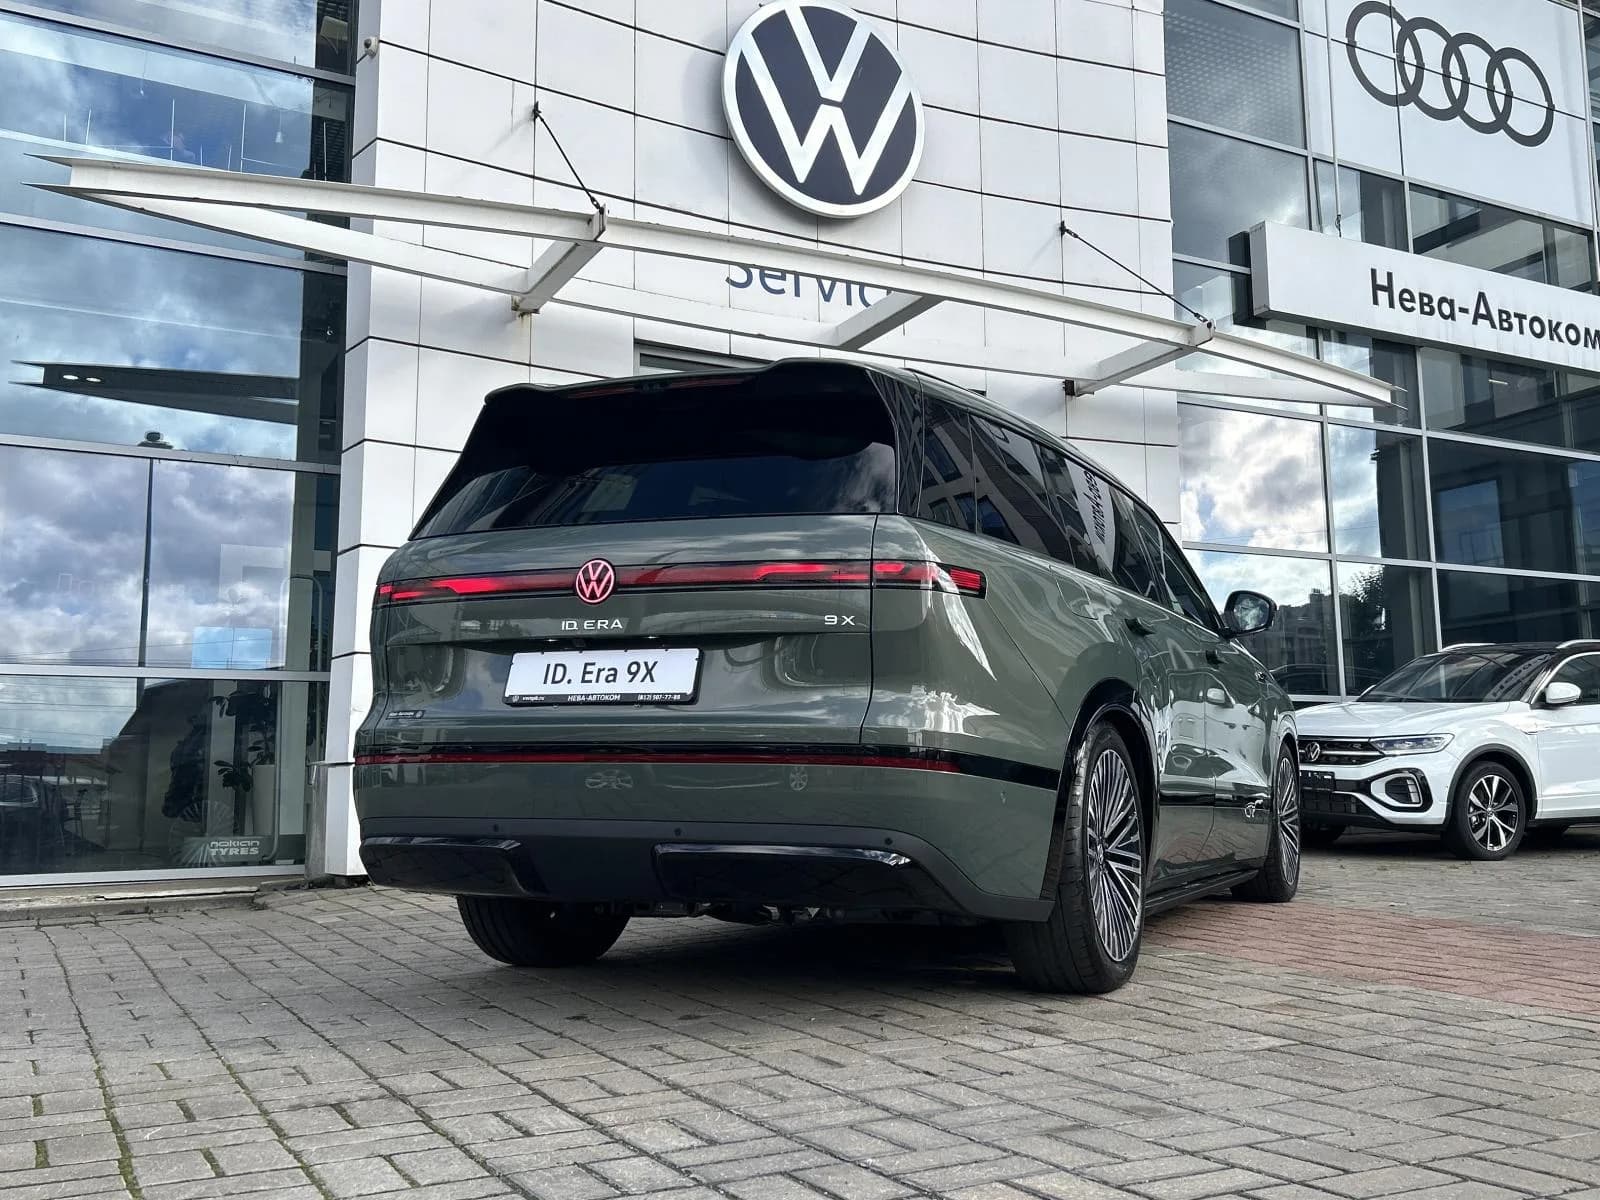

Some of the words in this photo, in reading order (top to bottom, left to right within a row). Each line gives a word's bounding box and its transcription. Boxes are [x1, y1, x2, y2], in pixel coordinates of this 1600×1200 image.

[1370, 268, 1600, 350] Нева-Автоком
[583, 619, 623, 630] ERA
[543, 663, 572, 685] ID.
[581, 661, 619, 684] Era
[627, 660, 658, 683] 9X
[567, 694, 621, 702] НЕВА-АВТОКОМ
[210, 847, 259, 856] TYRES
